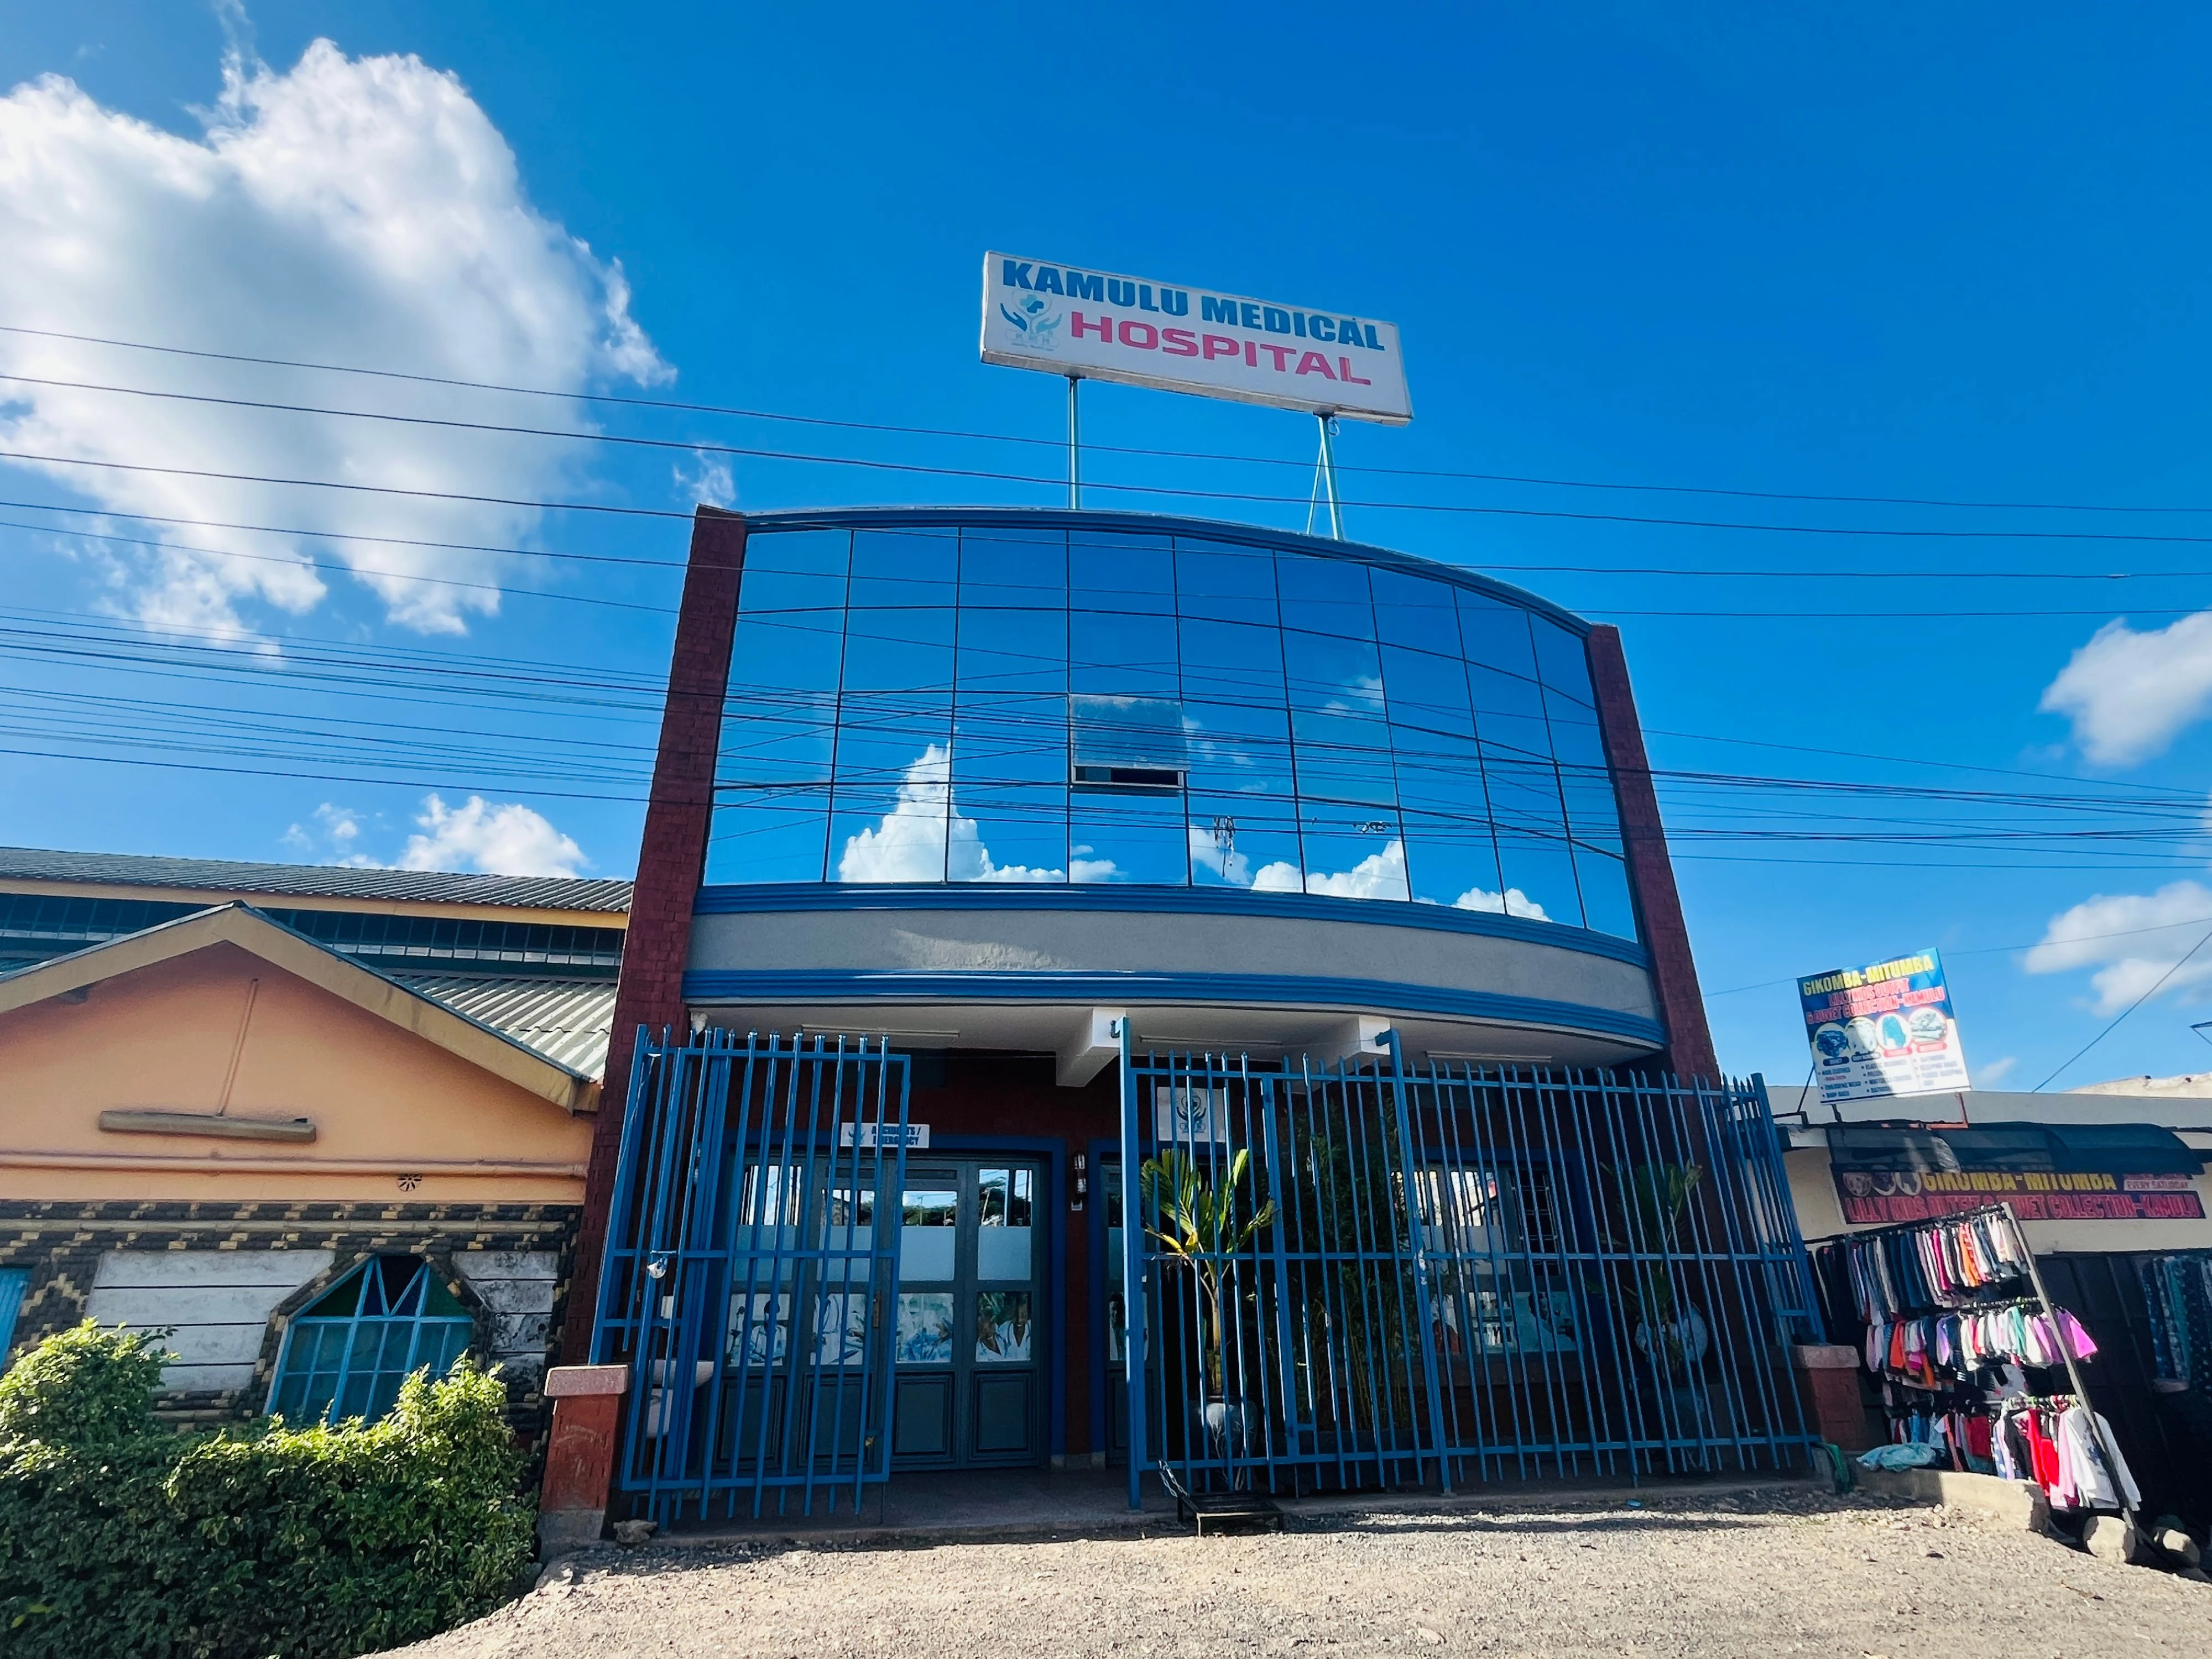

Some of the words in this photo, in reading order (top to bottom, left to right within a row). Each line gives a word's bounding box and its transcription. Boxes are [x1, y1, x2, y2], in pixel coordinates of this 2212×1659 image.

[1003, 259, 1188, 317] KAMULU
[1201, 295, 1385, 352] MEDICAL
[1071, 311, 1371, 385] HOSPITAL
[1803, 954, 1934, 996] GIKOMBA-MITUMBA
[1922, 1171, 2117, 1192] GIKOMBA-MITUMBA
[1845, 1197, 1888, 1222] LILLY
[1888, 1195, 1929, 1221] KIDS
